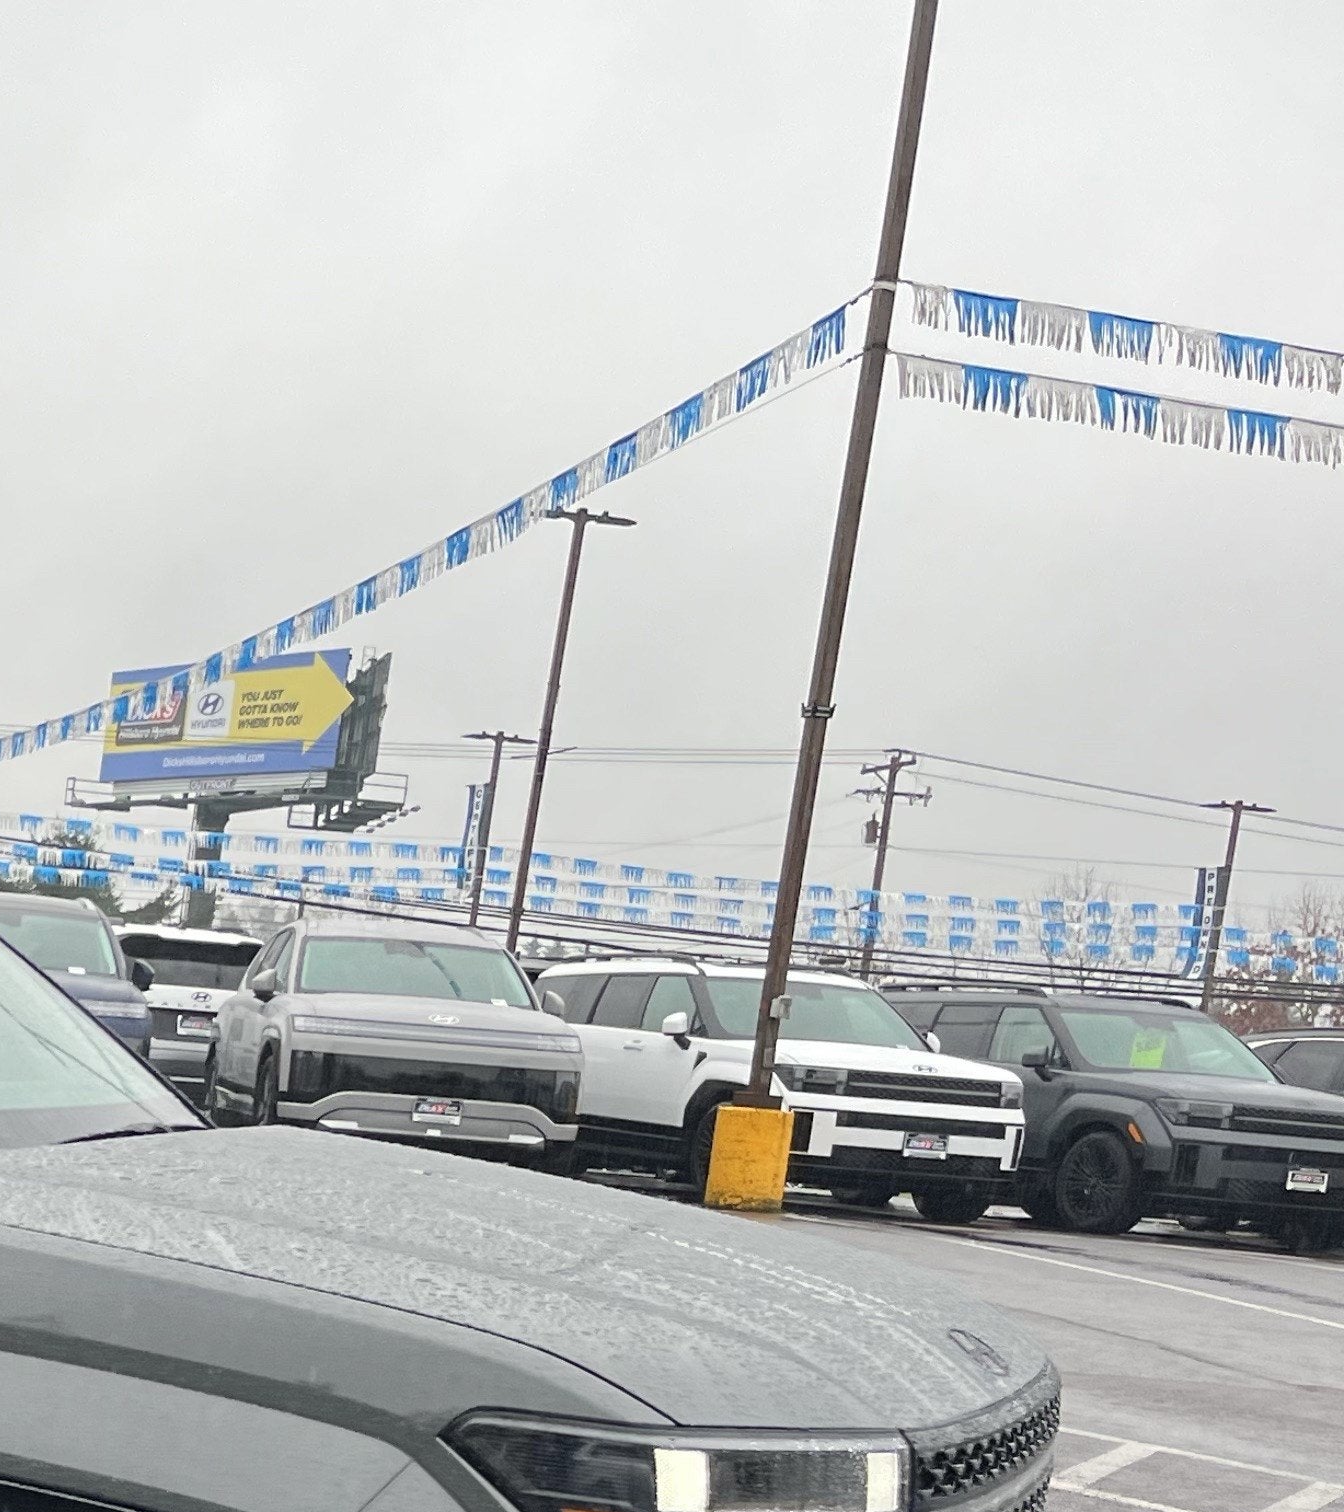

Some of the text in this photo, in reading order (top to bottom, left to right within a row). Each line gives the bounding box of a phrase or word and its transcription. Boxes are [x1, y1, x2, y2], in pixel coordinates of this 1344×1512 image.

[242, 689, 284, 703] YOU JUST
[239, 701, 299, 716] GOTTA KNOW
[191, 718, 226, 729] HYUNDAI
[238, 716, 270, 729] WHERE
[271, 716, 284, 726] TO
